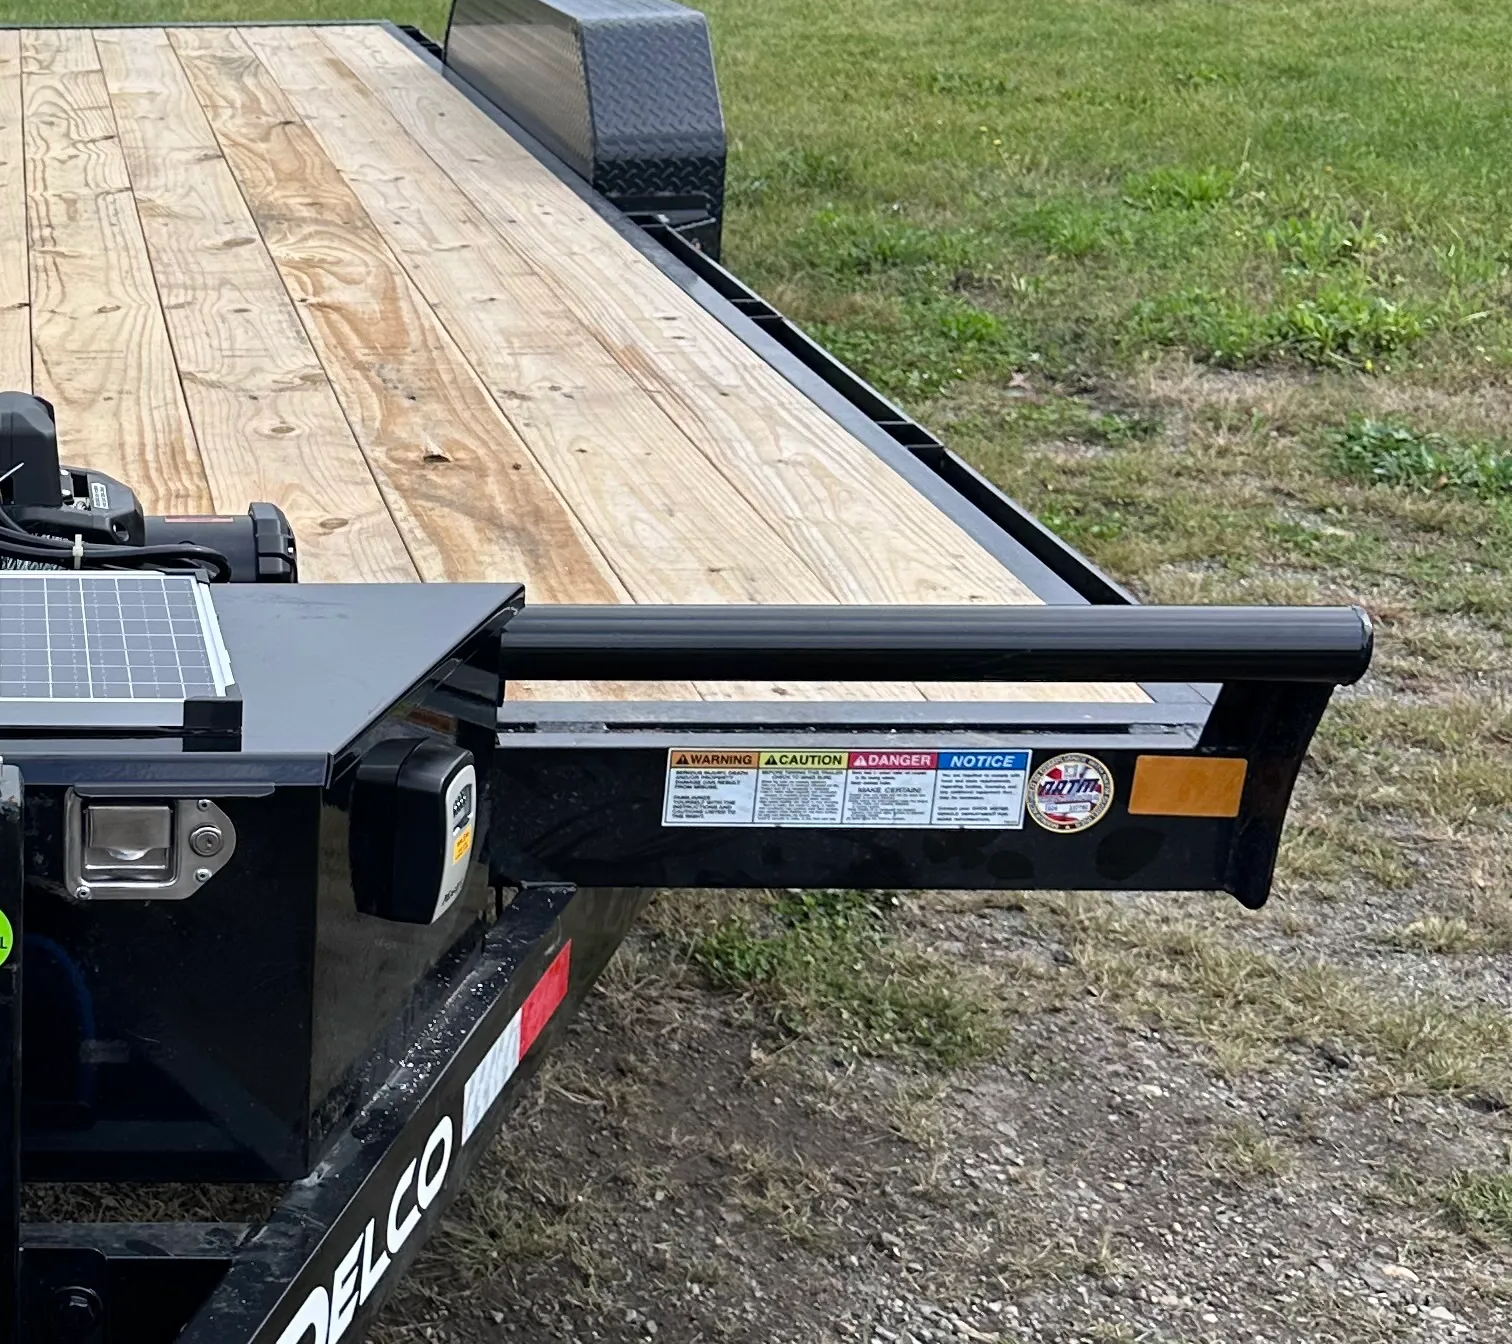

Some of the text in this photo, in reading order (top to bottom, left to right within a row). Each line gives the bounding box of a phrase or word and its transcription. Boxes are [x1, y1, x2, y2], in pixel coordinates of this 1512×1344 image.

[690, 754, 753, 766] WARNING
[778, 754, 843, 766] CAUTION
[868, 754, 932, 767] DANGER
[950, 755, 1016, 768] NOTICE
